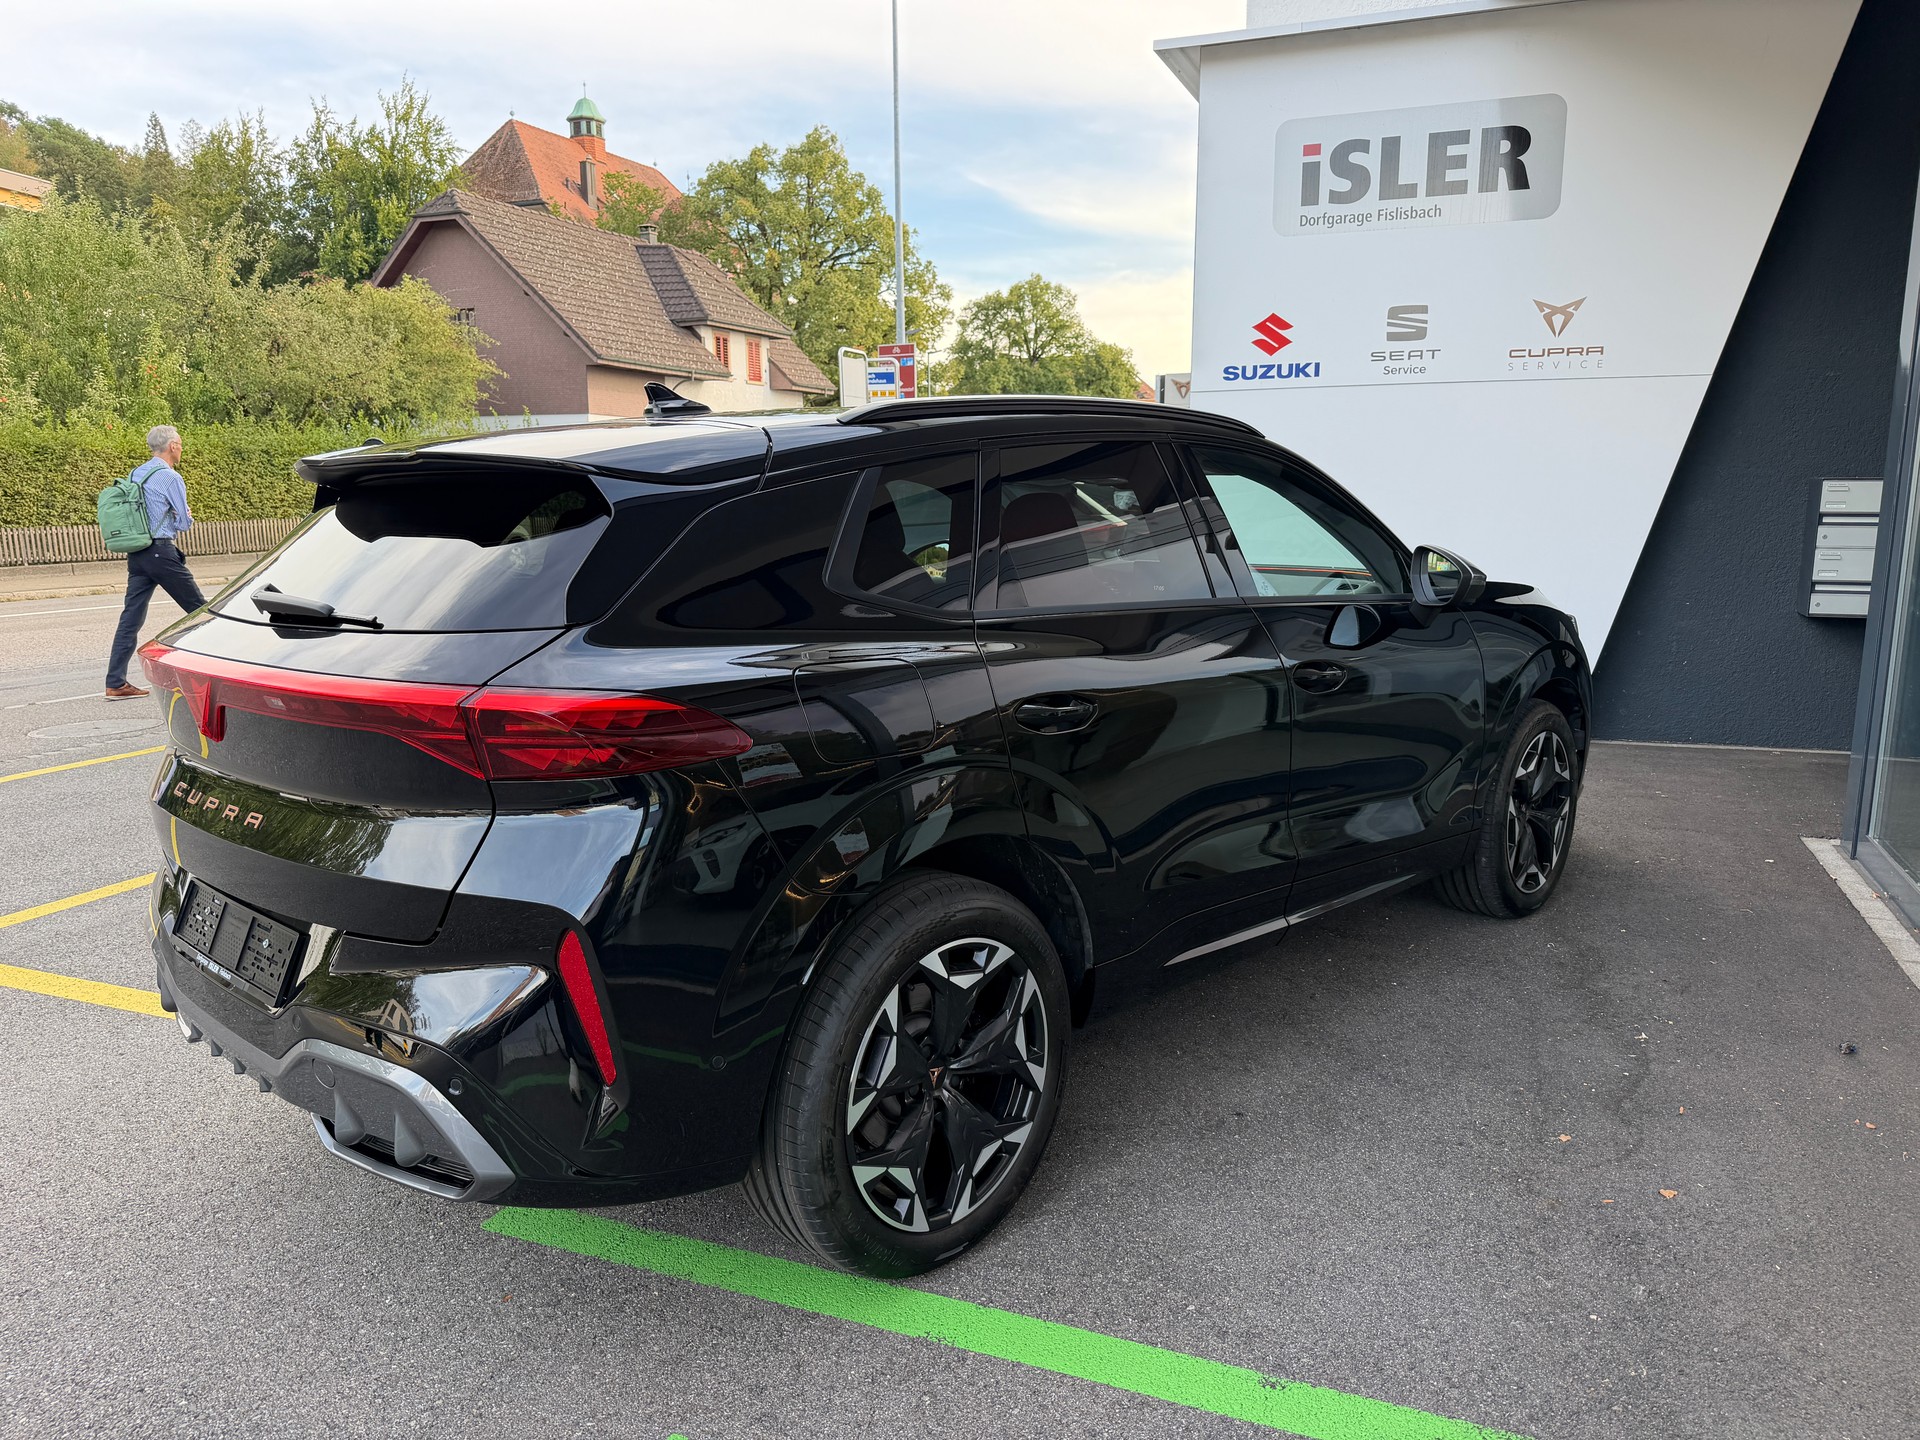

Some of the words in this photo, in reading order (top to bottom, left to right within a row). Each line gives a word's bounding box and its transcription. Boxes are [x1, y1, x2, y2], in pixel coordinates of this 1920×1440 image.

[1300, 125, 1532, 207] iSLER
[1299, 212, 1373, 229] Dorfgarage
[1377, 204, 1442, 222] Fislisbach
[1370, 348, 1442, 362] SEAT
[1508, 345, 1605, 359] CUPRA
[1222, 361, 1321, 381] SUZUKI
[1382, 364, 1427, 375] Service
[1507, 359, 1604, 371] SERVICE
[173, 781, 264, 829] CUPRA
